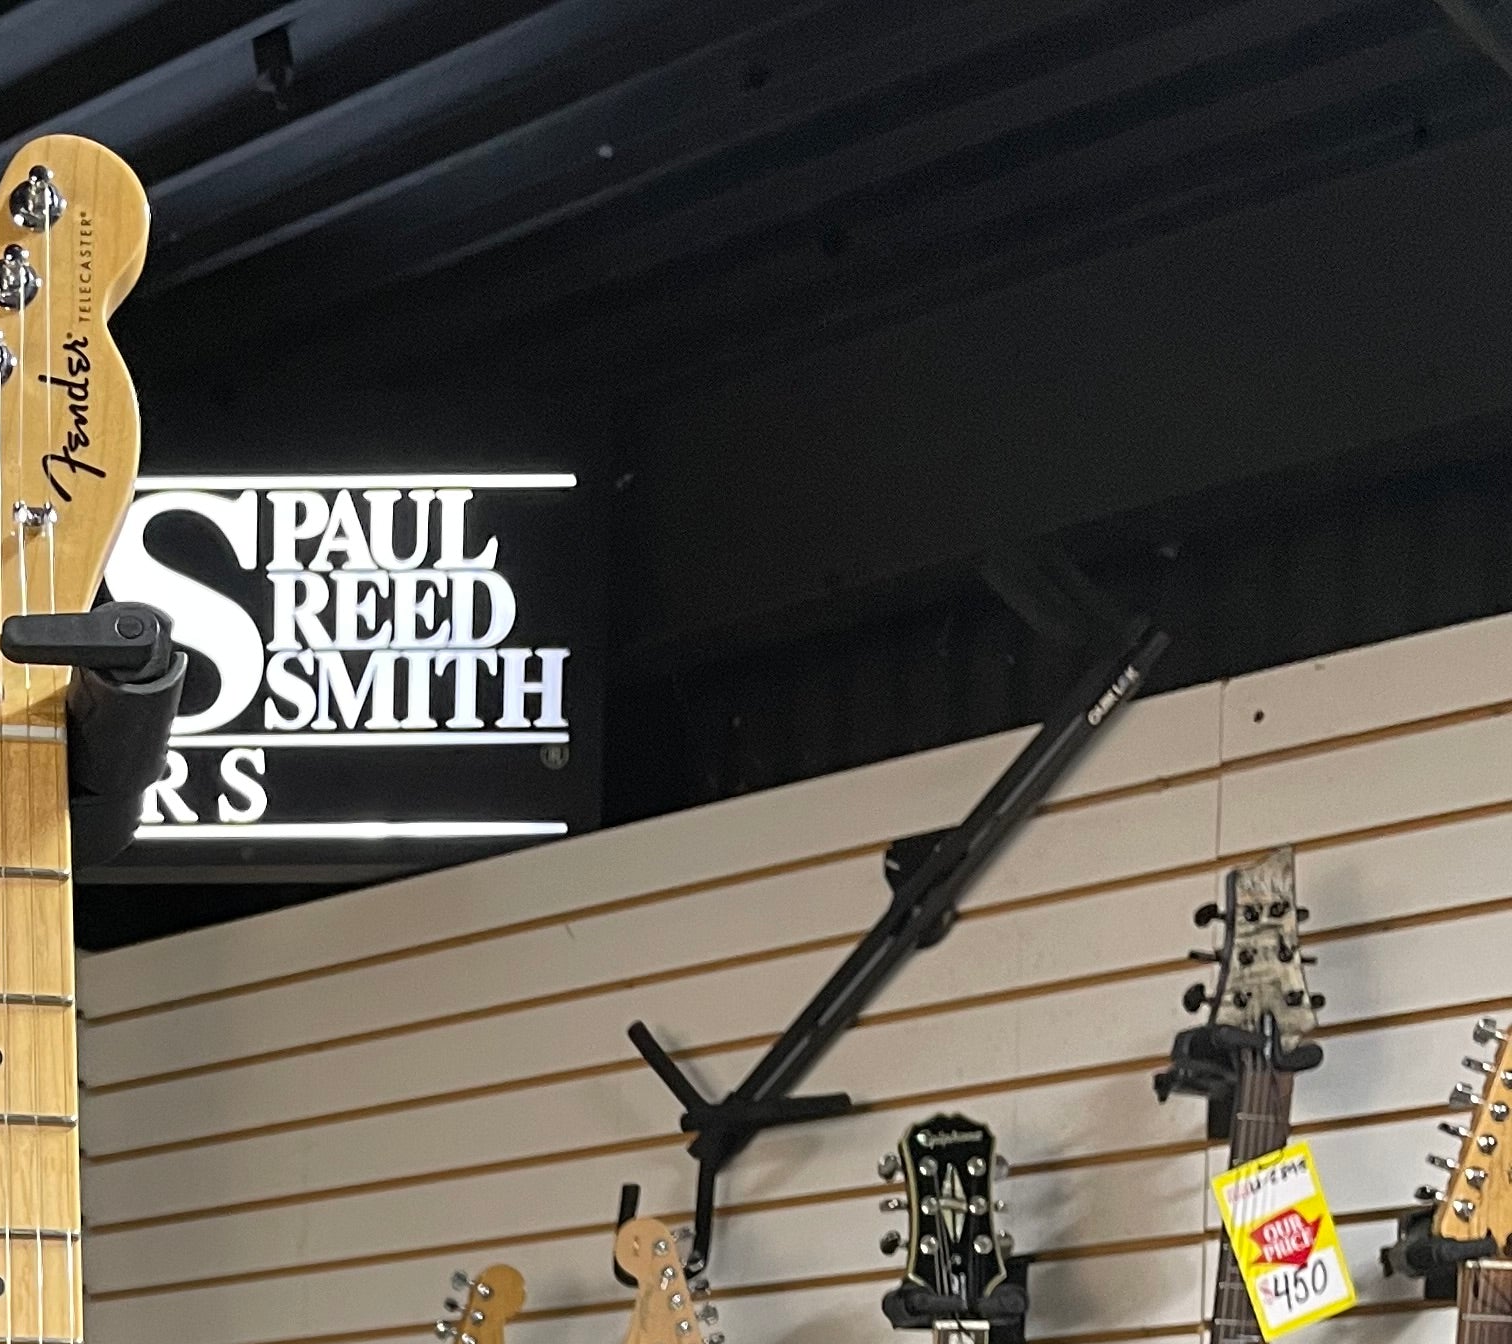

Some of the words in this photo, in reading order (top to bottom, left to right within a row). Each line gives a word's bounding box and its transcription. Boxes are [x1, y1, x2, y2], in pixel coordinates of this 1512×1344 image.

[78, 219, 94, 324] TELECASTER
[38, 333, 106, 503] Fender
[265, 488, 499, 572] PAUL
[265, 568, 518, 651] REED
[263, 646, 572, 732] SMITH
[1262, 1213, 1305, 1244] OUR
